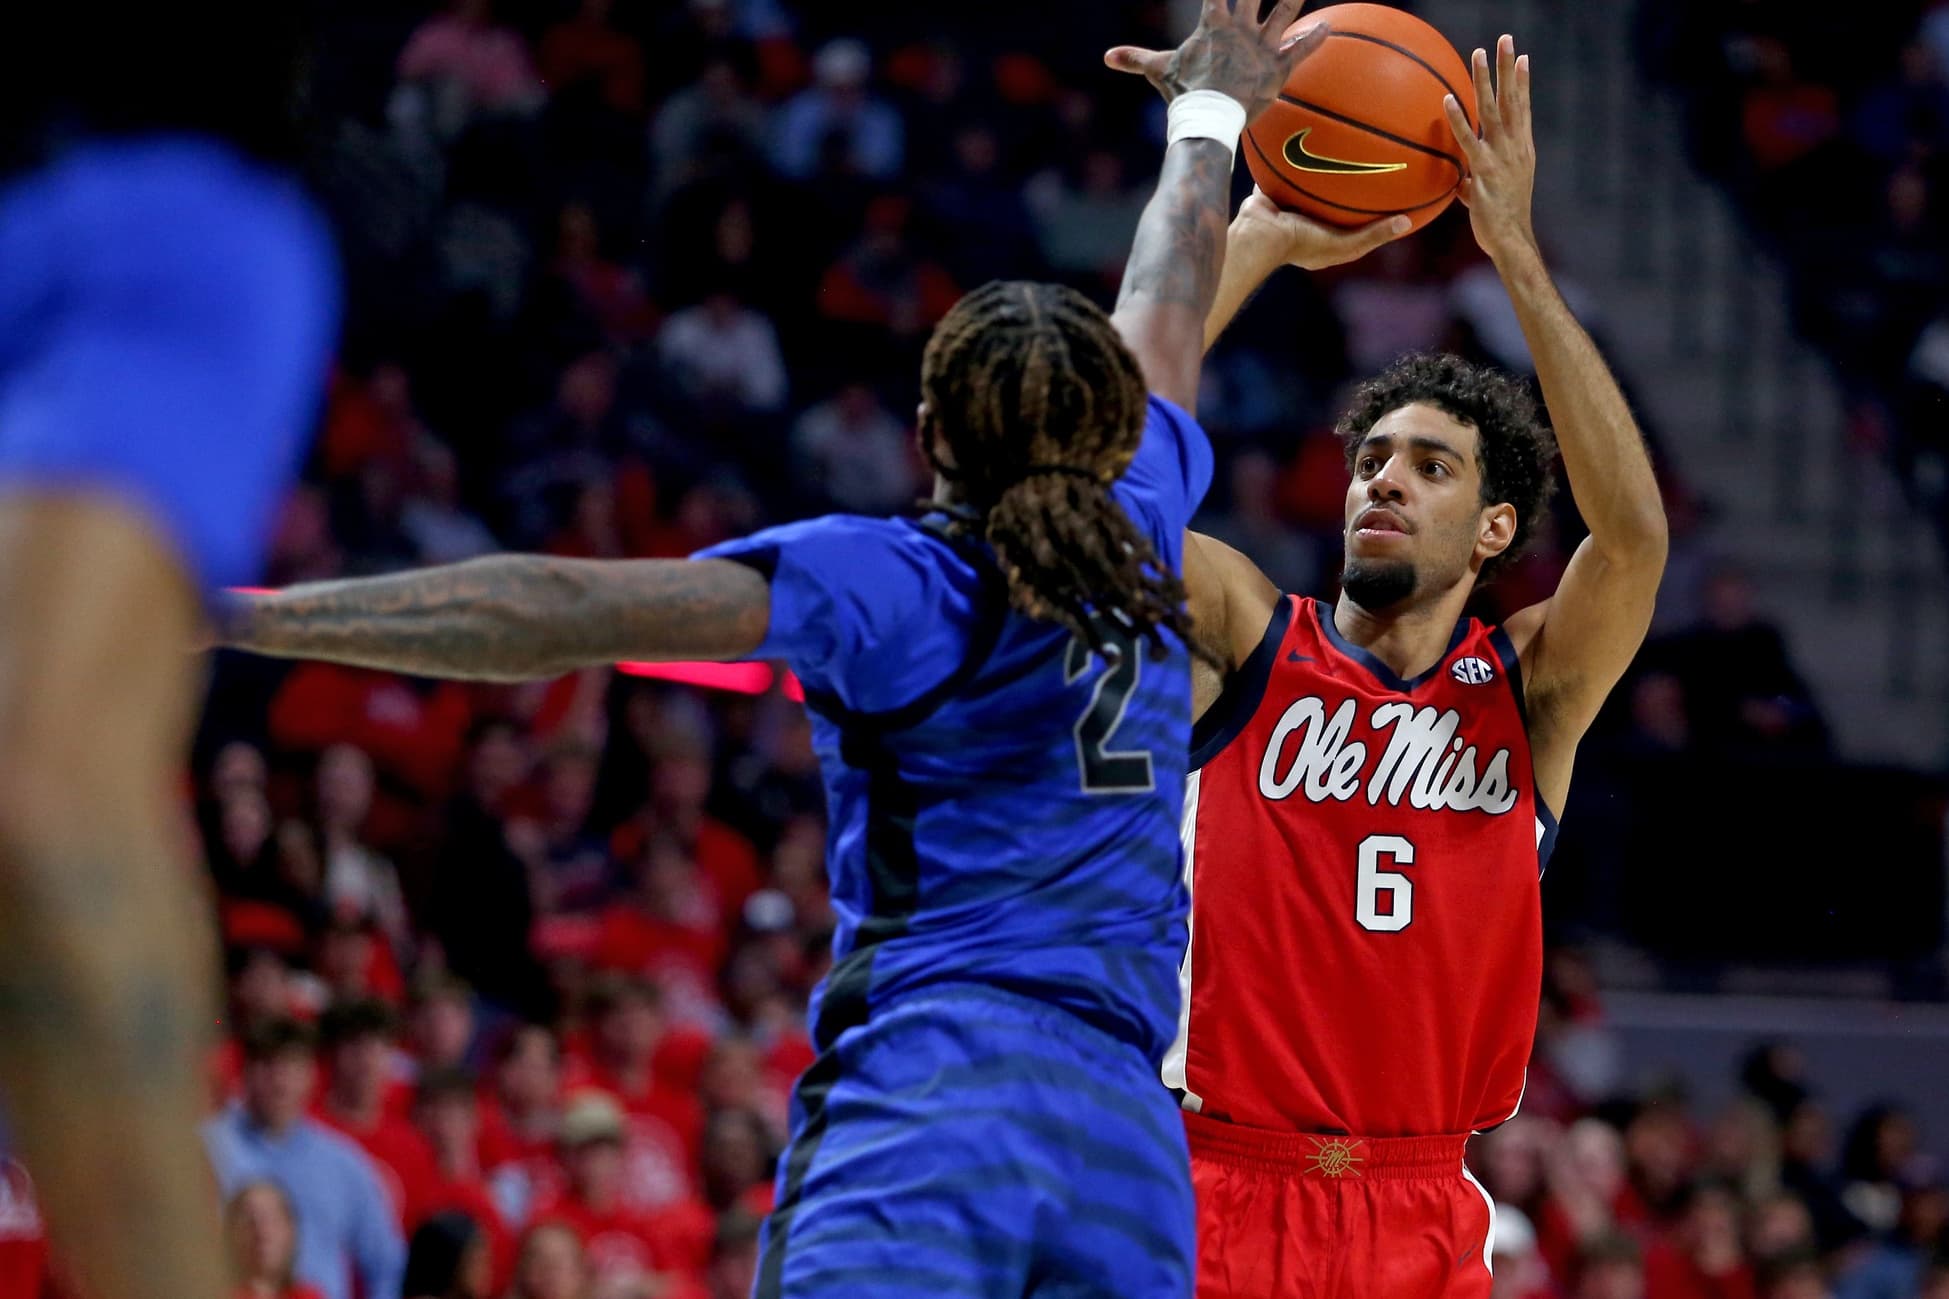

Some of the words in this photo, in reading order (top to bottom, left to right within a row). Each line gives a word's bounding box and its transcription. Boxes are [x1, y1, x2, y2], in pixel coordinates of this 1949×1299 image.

[1064, 607, 1156, 794] 2
[1452, 657, 1493, 684] SEC
[1259, 697, 1367, 802] Ole
[1367, 704, 1518, 814] Miss
[1357, 835, 1414, 931] 6
